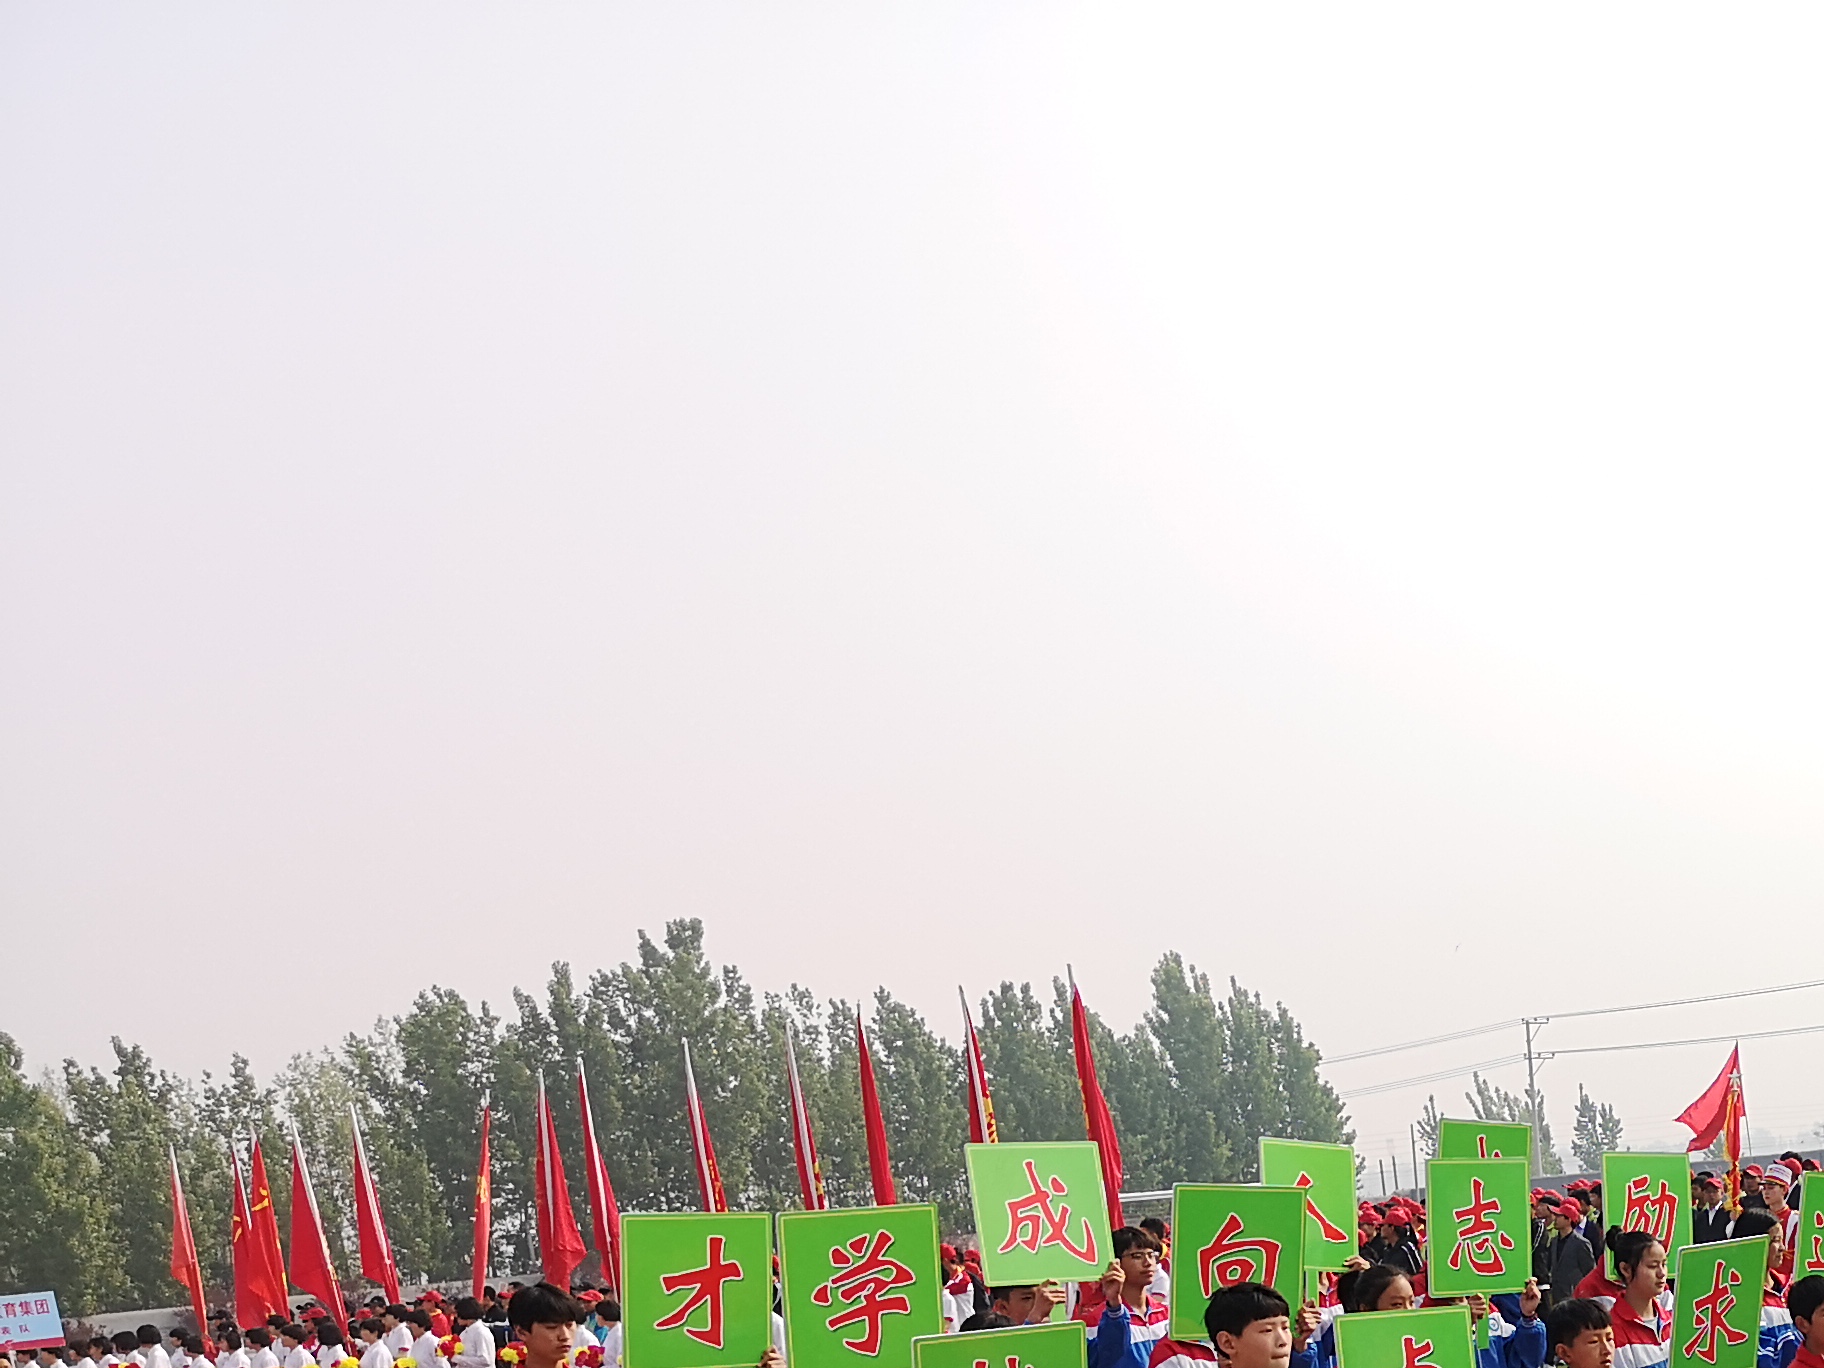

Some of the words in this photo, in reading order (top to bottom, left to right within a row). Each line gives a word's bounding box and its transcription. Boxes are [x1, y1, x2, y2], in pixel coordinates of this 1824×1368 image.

[998, 1159, 1099, 1265] 成
[1197, 1211, 1282, 1299] 向
[1448, 1177, 1515, 1276] 志
[1622, 1175, 1679, 1256] 励
[0, 1298, 51, 1318] 育集团
[654, 1234, 744, 1350] 才
[811, 1228, 916, 1357] 学
[1682, 1258, 1749, 1365] 求
